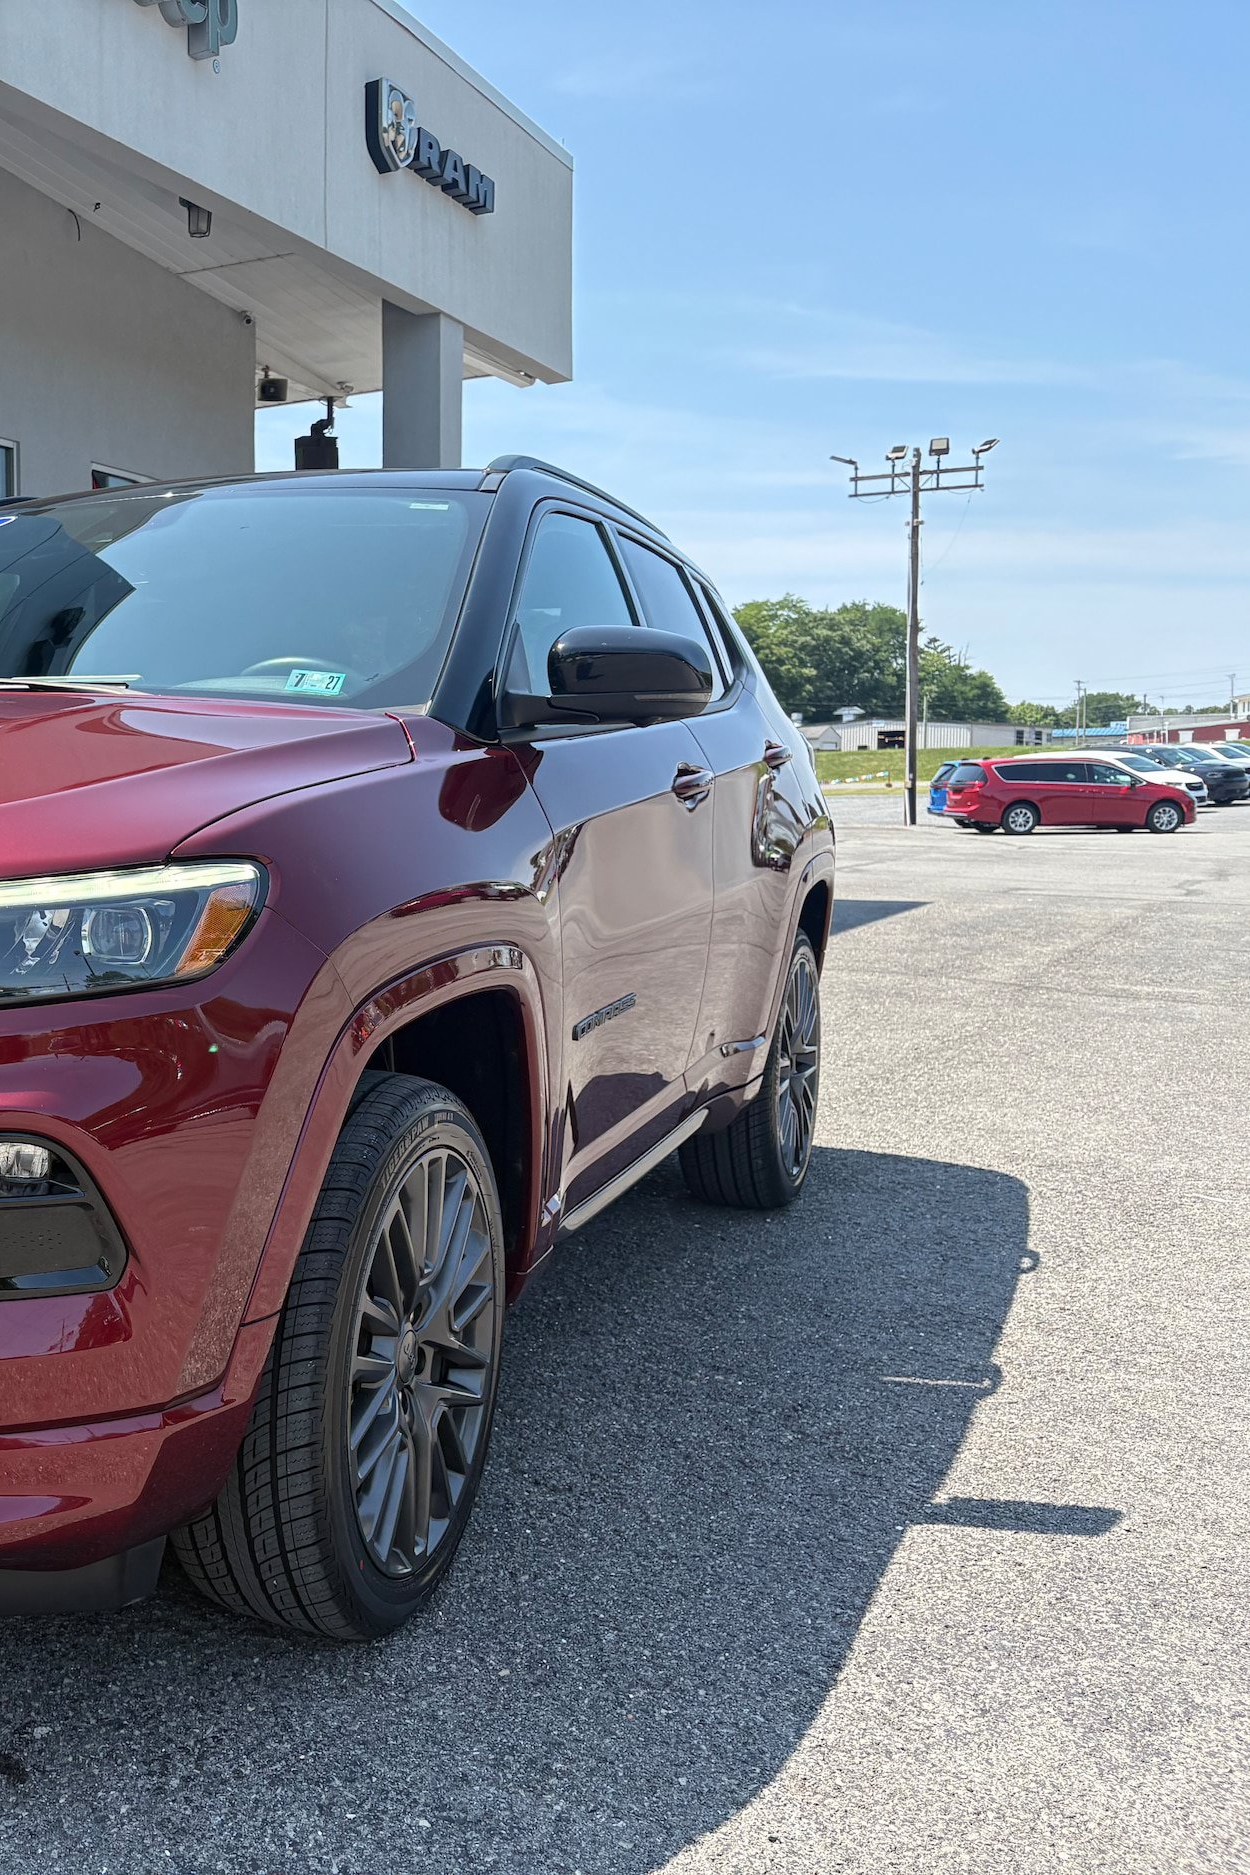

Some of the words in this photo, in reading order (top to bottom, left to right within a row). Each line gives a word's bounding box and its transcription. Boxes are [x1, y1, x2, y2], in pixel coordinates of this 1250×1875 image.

[406, 126, 495, 215] RAM
[324, 675, 341, 691] 27
[380, 1140, 407, 1189] TIGER
[411, 1115, 430, 1144] PAW
